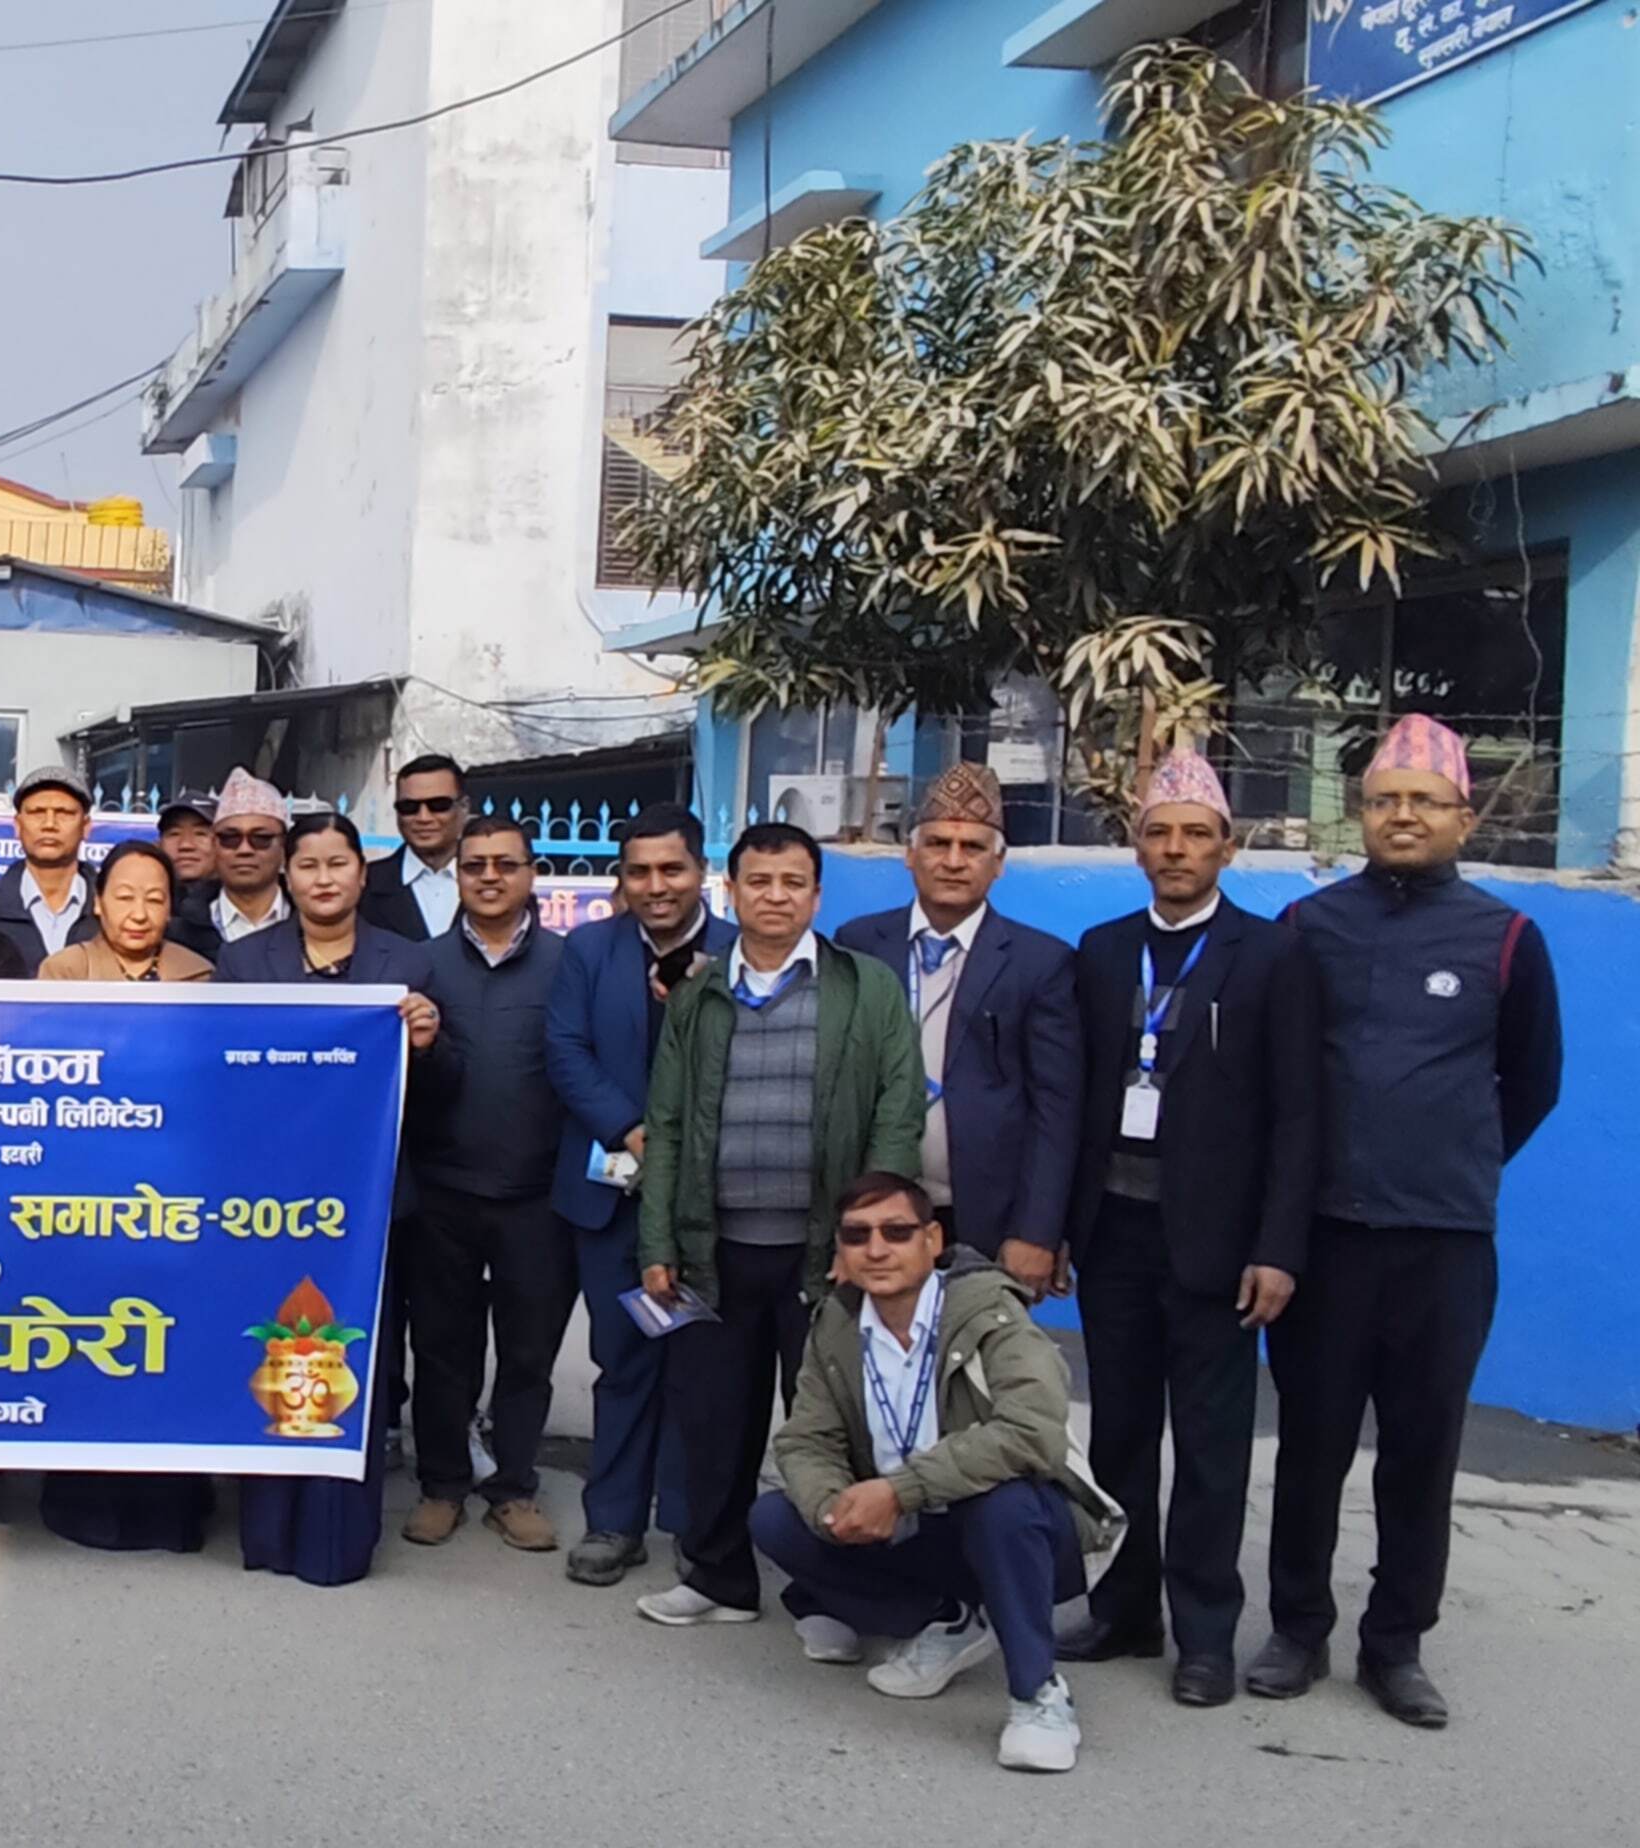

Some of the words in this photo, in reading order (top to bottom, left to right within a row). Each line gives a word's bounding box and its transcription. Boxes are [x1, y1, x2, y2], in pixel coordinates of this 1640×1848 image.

[55, 1095, 164, 1129] लिमिटेड)
[0, 1139, 44, 1166] इटहरी
[9, 1182, 347, 1243] समारोह-२०८२
